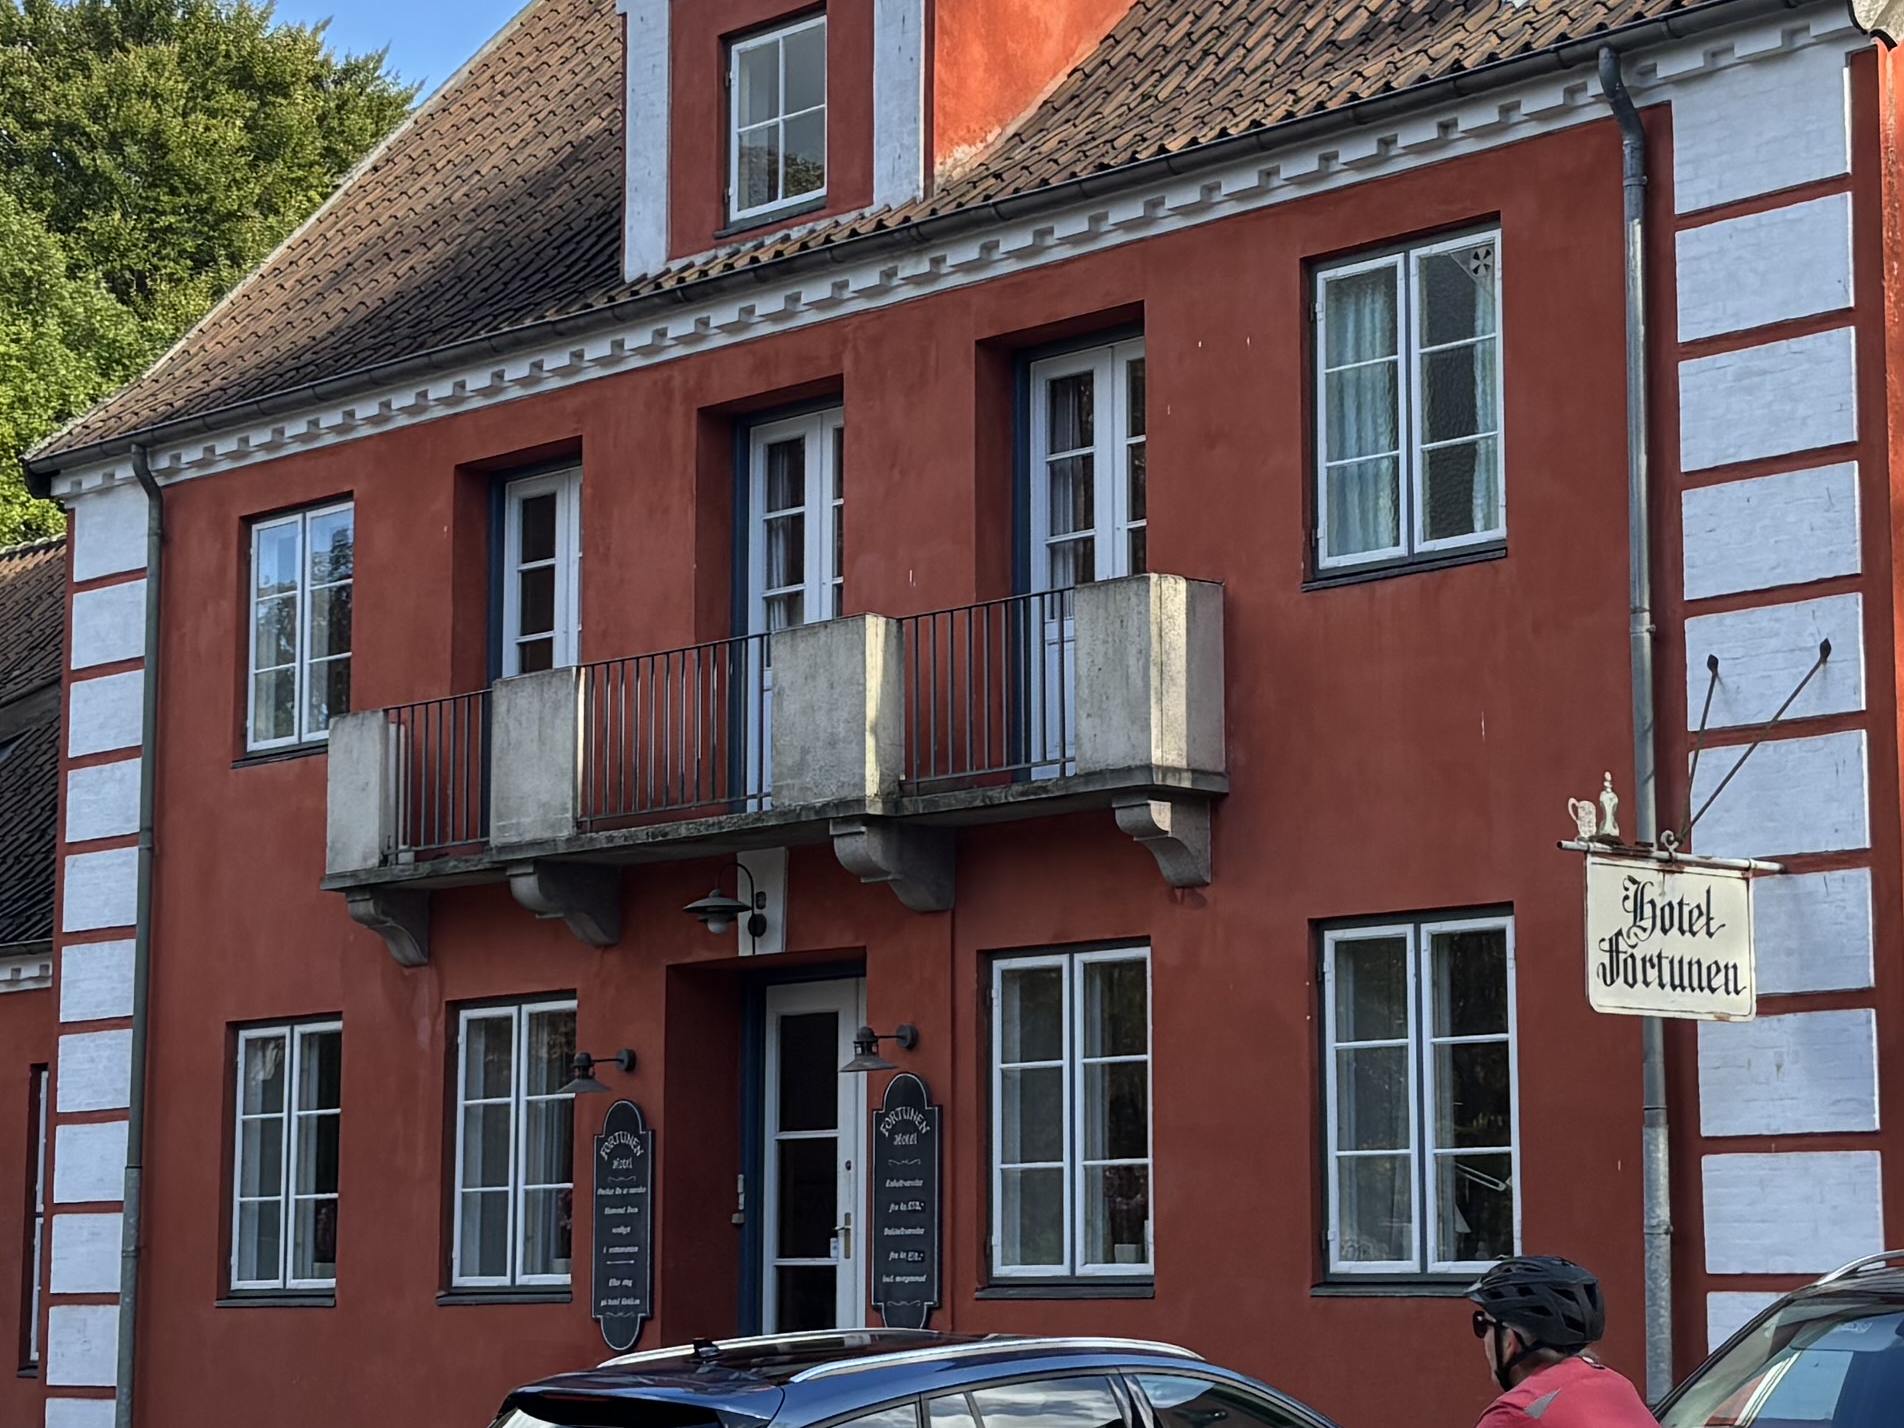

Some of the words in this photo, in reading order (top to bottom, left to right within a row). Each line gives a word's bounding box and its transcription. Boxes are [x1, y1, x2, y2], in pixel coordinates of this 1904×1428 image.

[1622, 875, 1726, 942] Hotel
[1597, 927, 1747, 996] Fortunen
[600, 1131, 644, 1161] FORTUNEN
[880, 1106, 930, 1138] FORTUNEN
